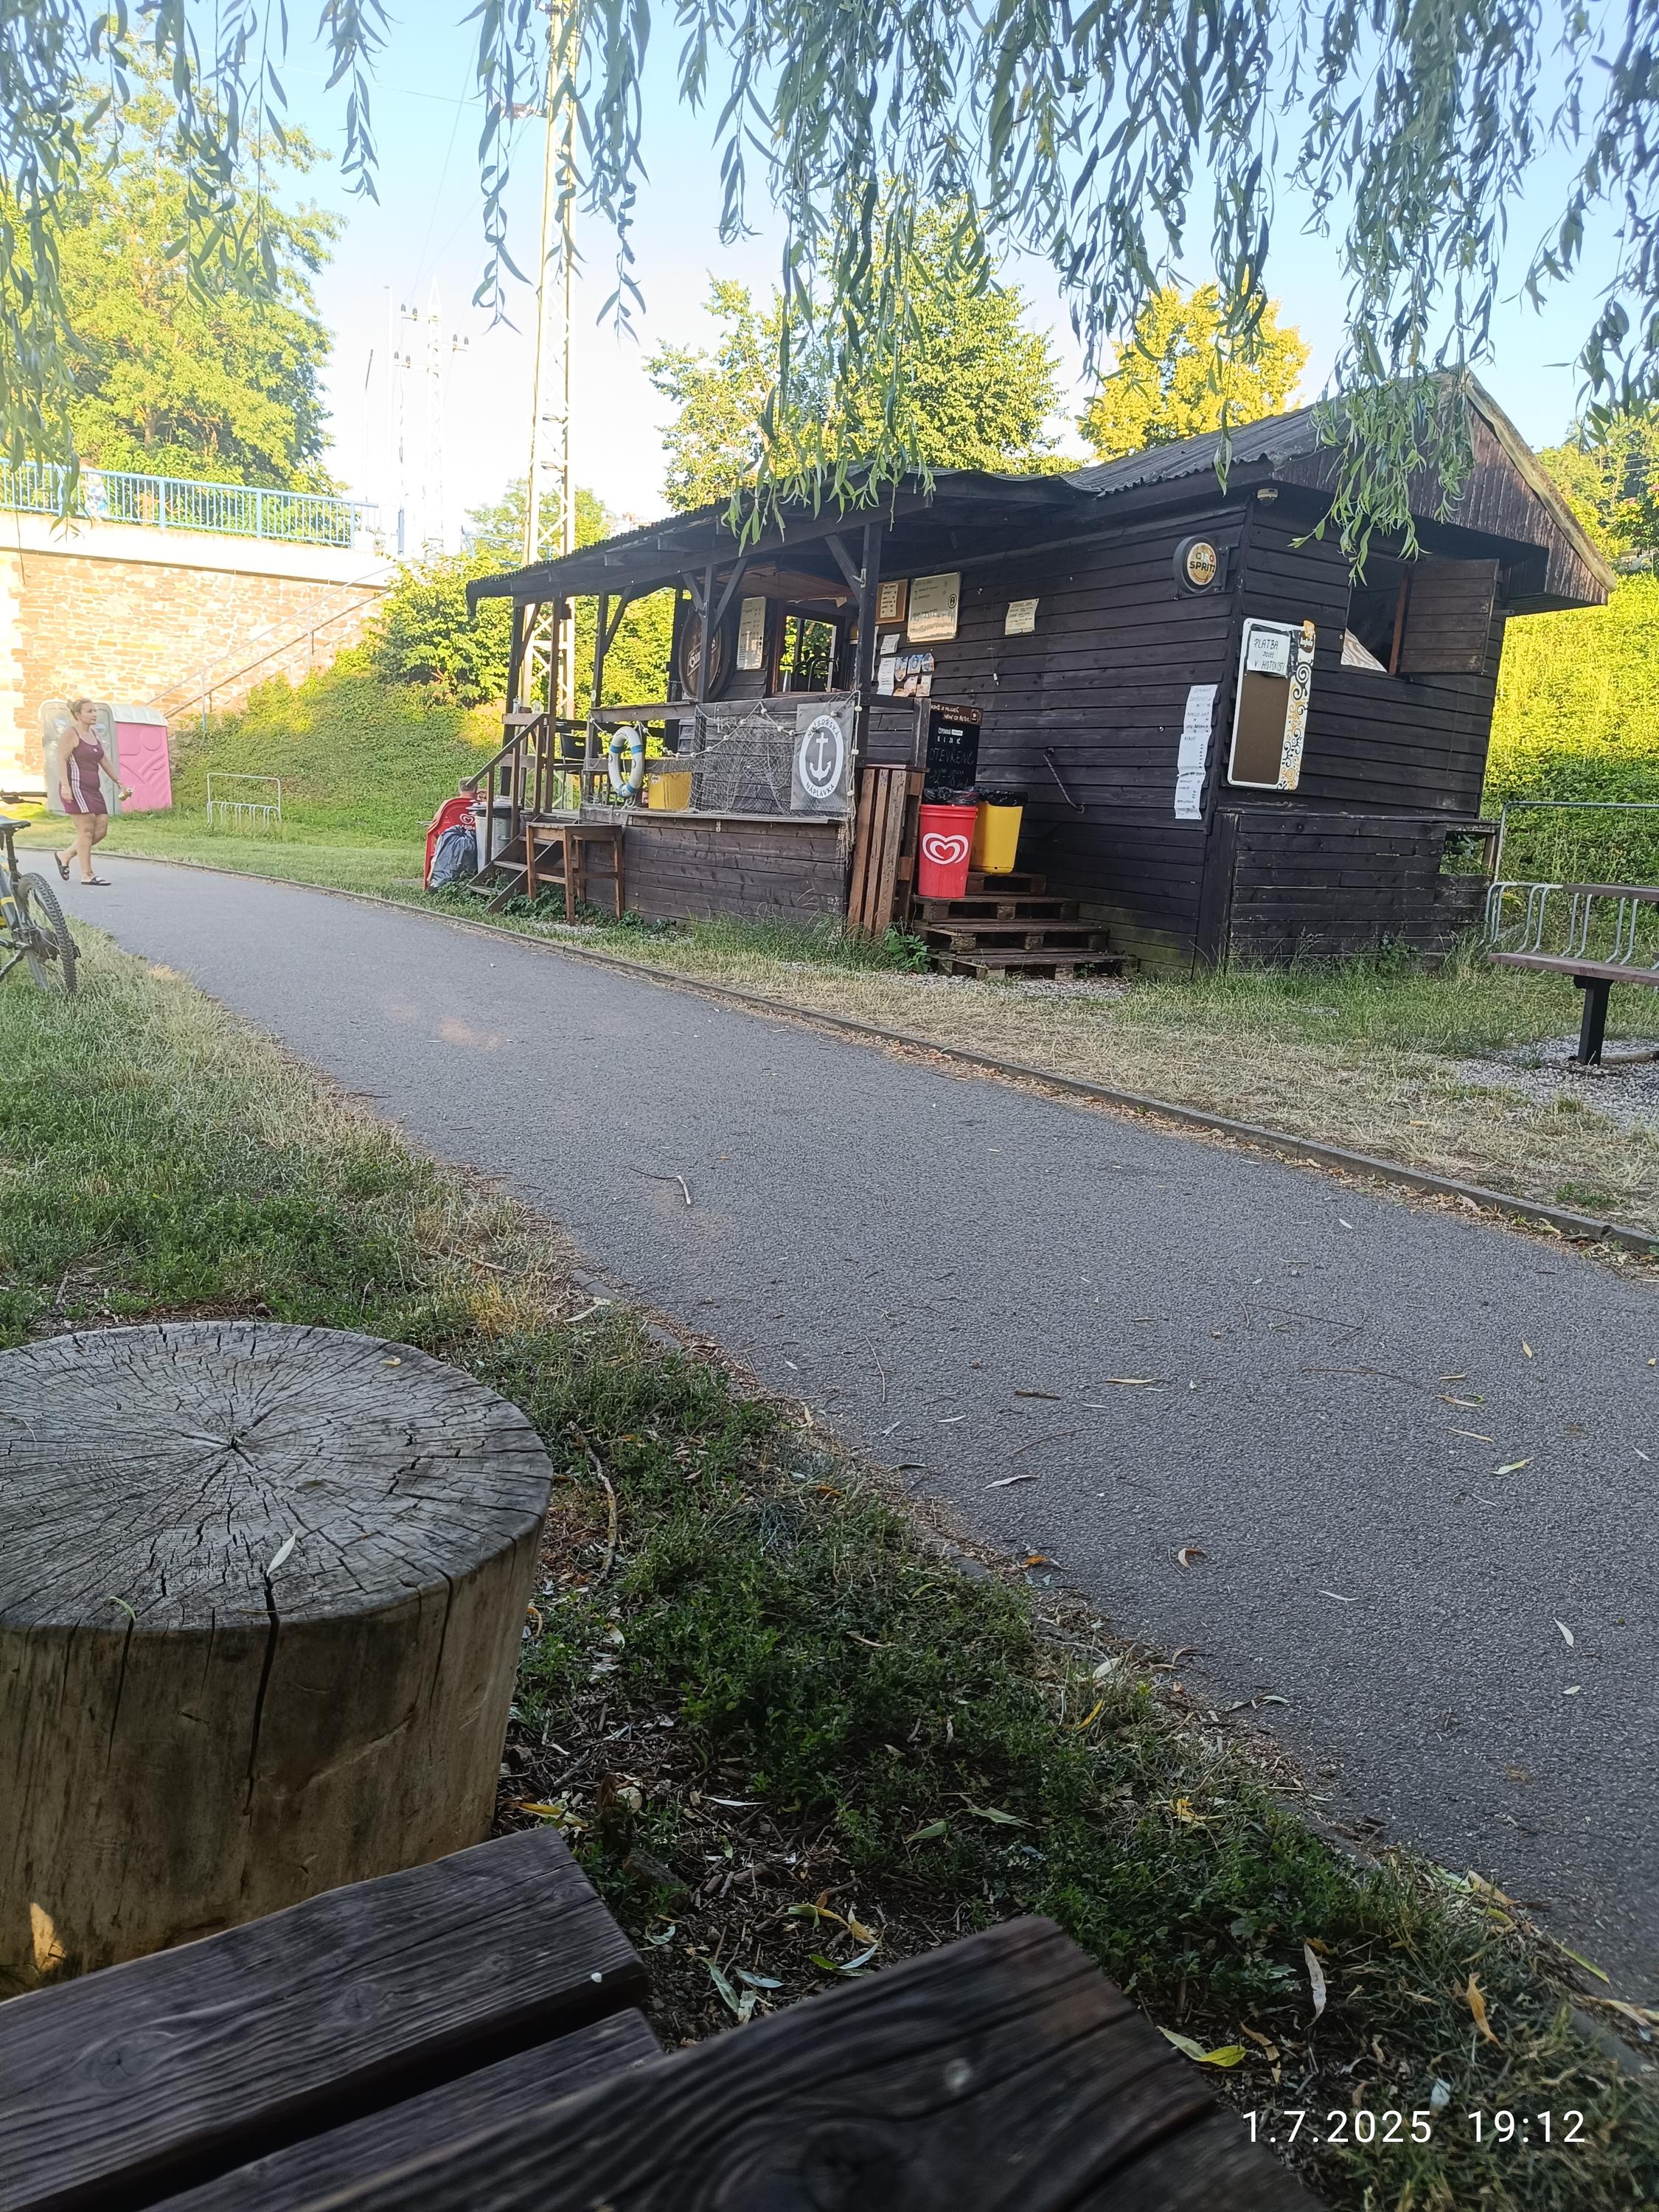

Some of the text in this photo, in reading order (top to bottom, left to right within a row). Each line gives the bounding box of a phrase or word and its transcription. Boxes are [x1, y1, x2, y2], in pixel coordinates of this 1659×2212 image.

[1196, 552, 1214, 563] CIAO
[1253, 638, 1279, 650] PLATBA
[805, 782, 835, 797] NÁPLAVKA
